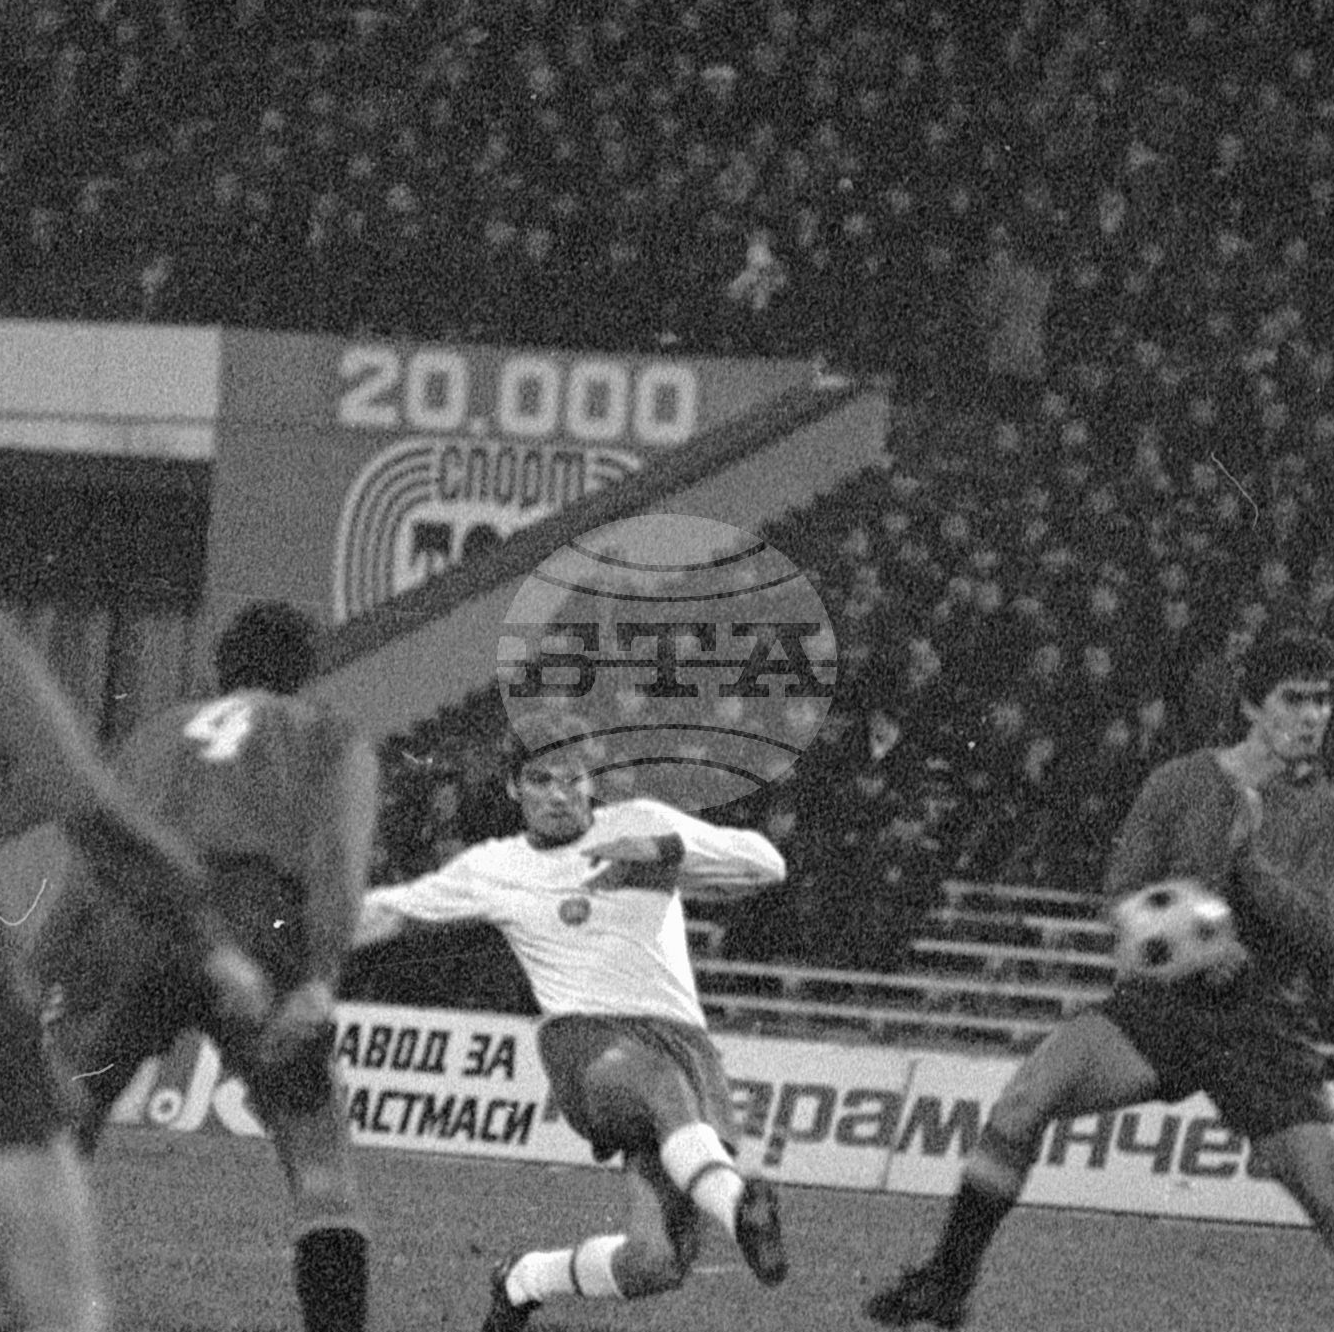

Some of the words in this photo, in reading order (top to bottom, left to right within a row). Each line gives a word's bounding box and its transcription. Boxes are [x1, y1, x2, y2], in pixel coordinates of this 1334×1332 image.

[337, 345, 698, 445] 20.000
[183, 691, 254, 761] 4
[337, 1022, 452, 1074] АВОД
[460, 1031, 517, 1080] ЗА
[348, 1087, 538, 1146] АСТМАСИ
